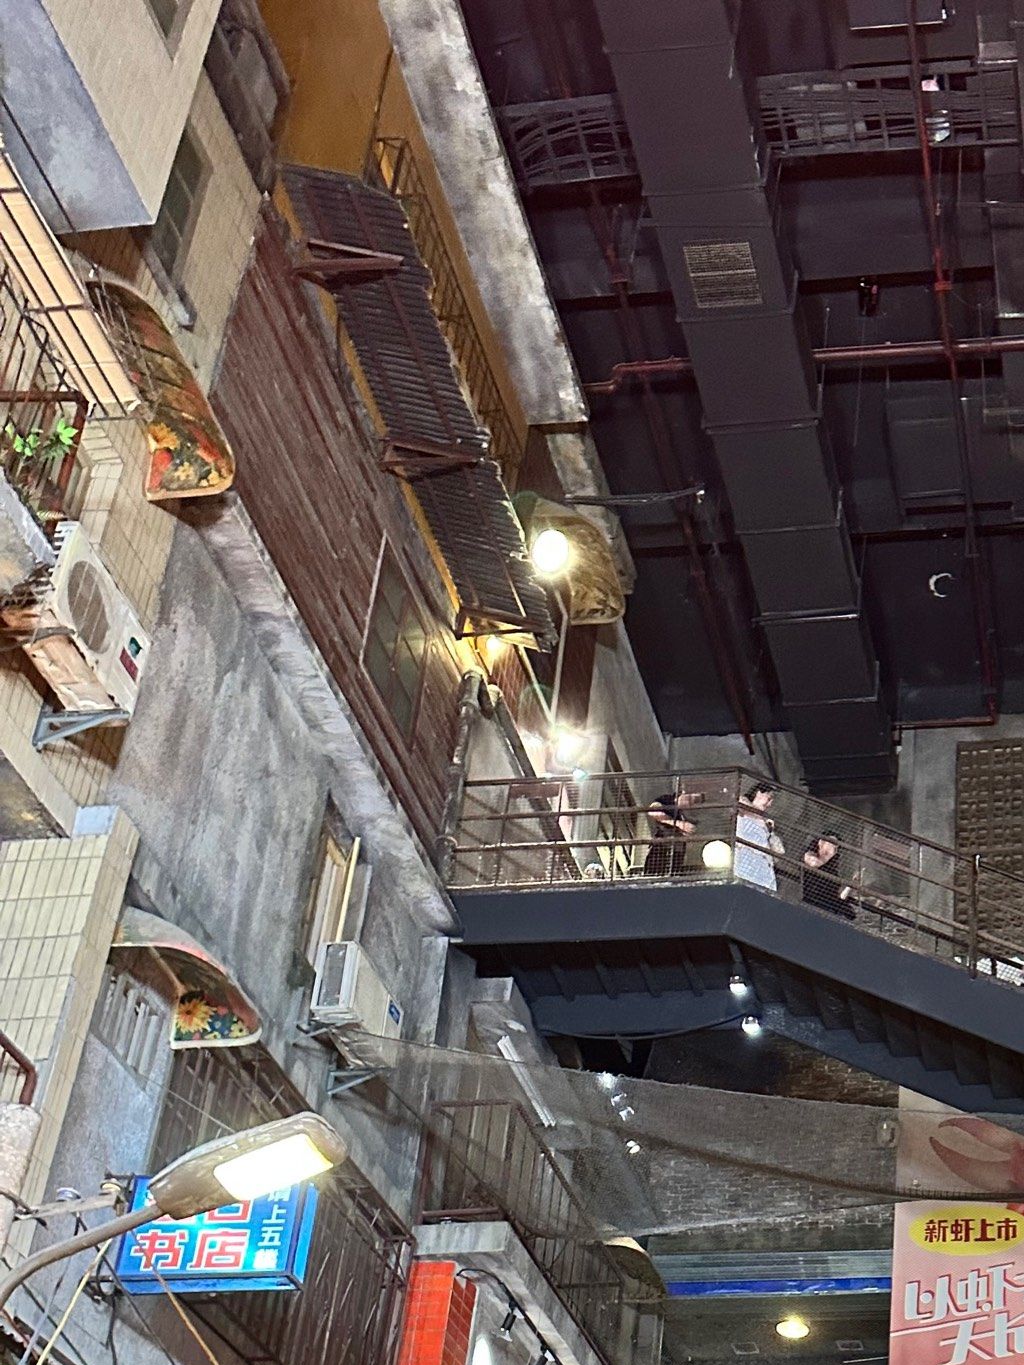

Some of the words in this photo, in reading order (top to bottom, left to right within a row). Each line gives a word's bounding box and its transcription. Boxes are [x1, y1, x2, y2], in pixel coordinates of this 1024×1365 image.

[924, 1218, 1018, 1243] 新虾上市
[130, 1229, 250, 1270] 书店
